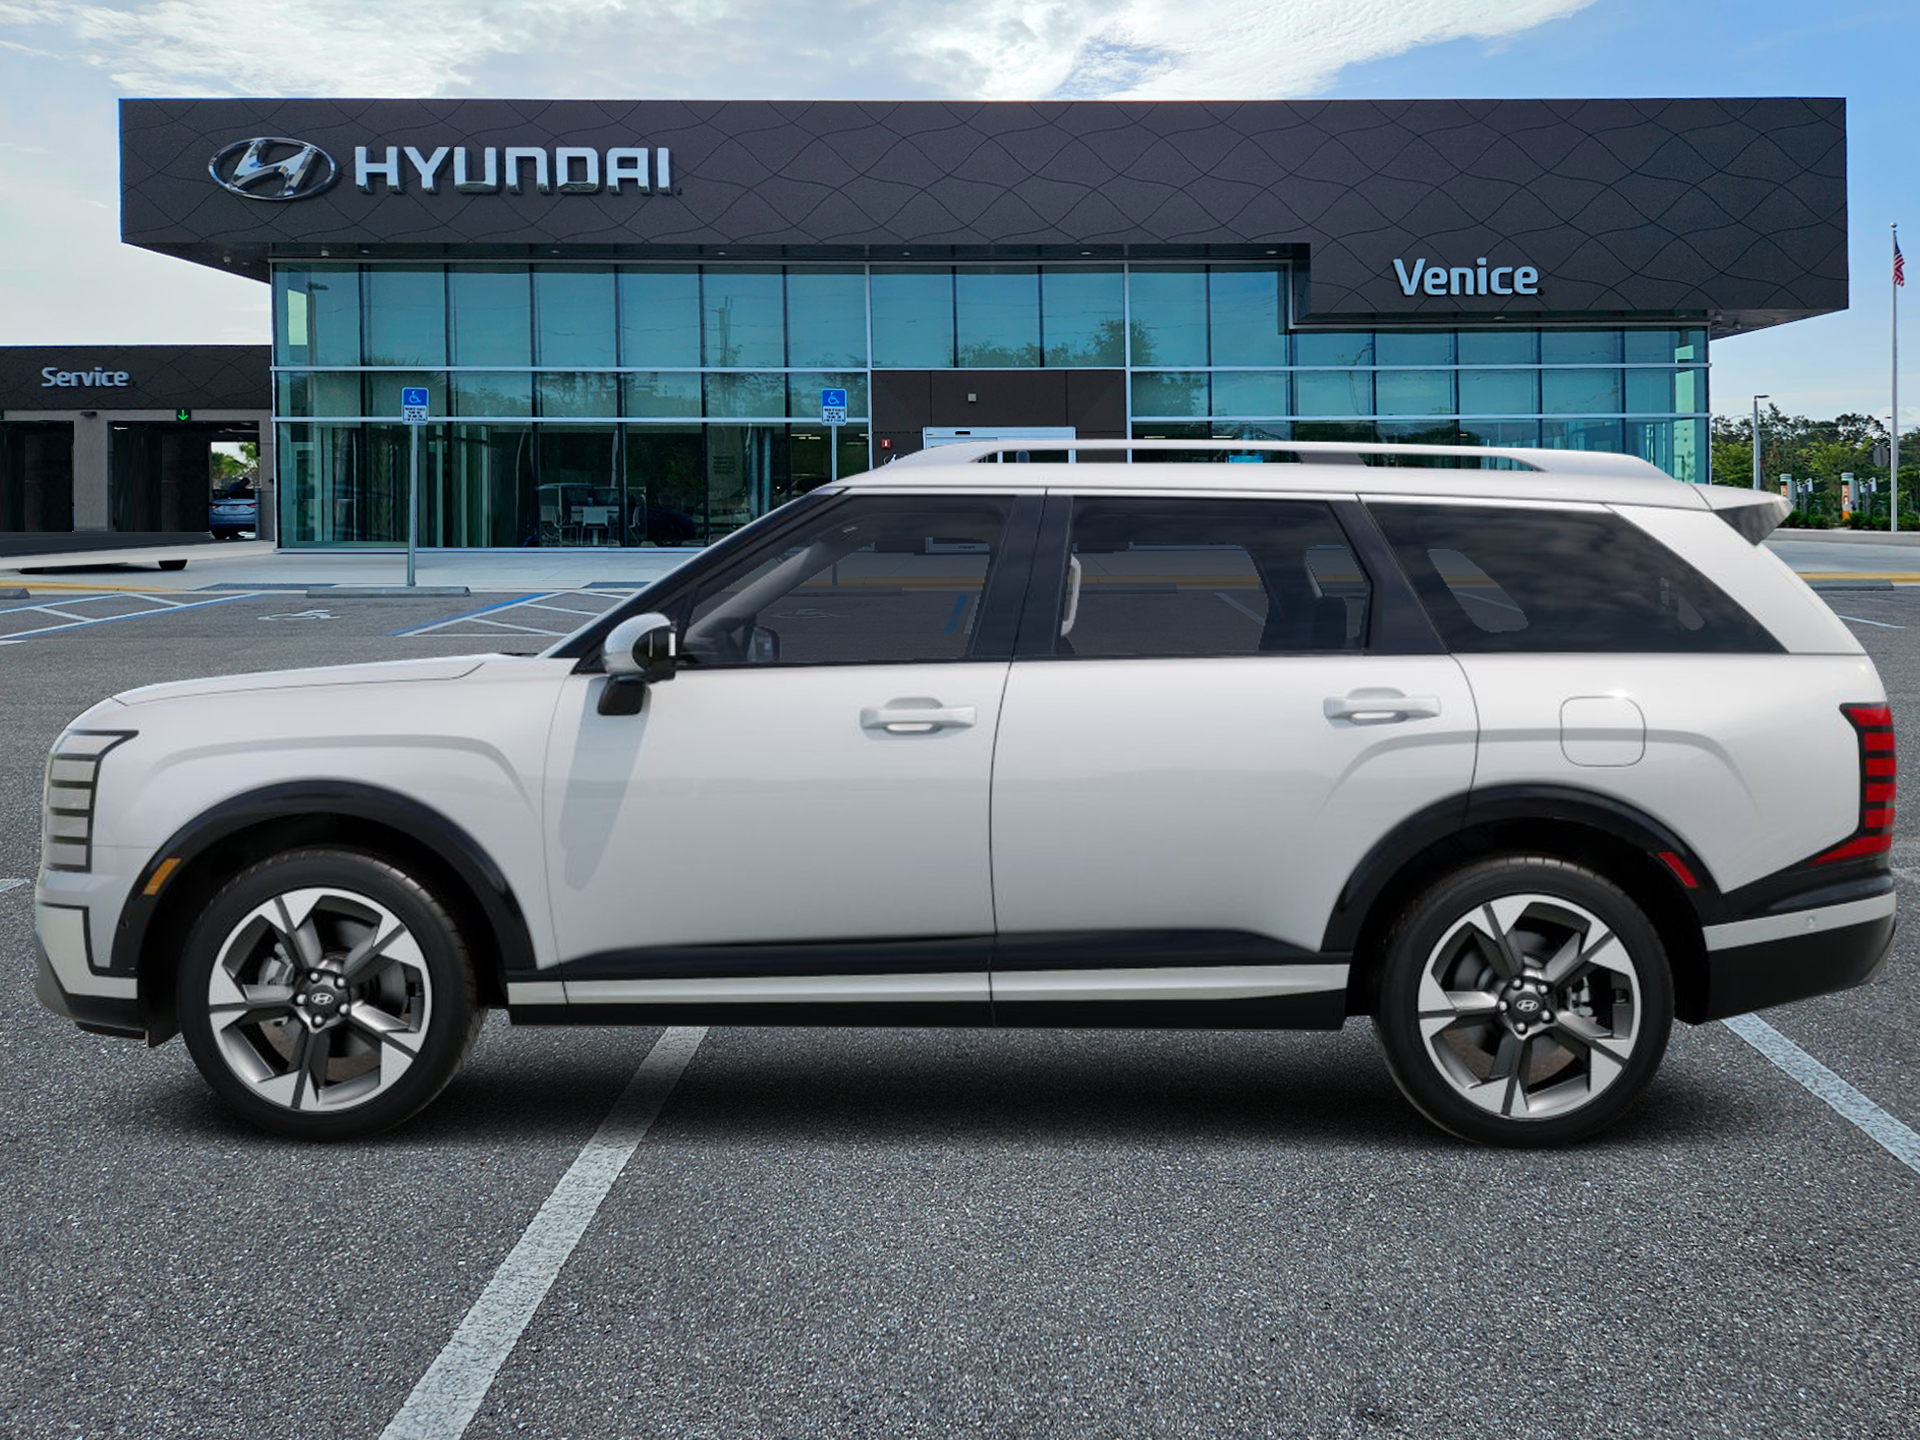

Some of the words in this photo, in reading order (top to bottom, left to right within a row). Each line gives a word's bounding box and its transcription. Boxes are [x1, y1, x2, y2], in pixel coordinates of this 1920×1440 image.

[354, 146, 672, 193] HYUNDAI
[1392, 257, 1539, 296] Venice
[41, 366, 130, 387] Service
